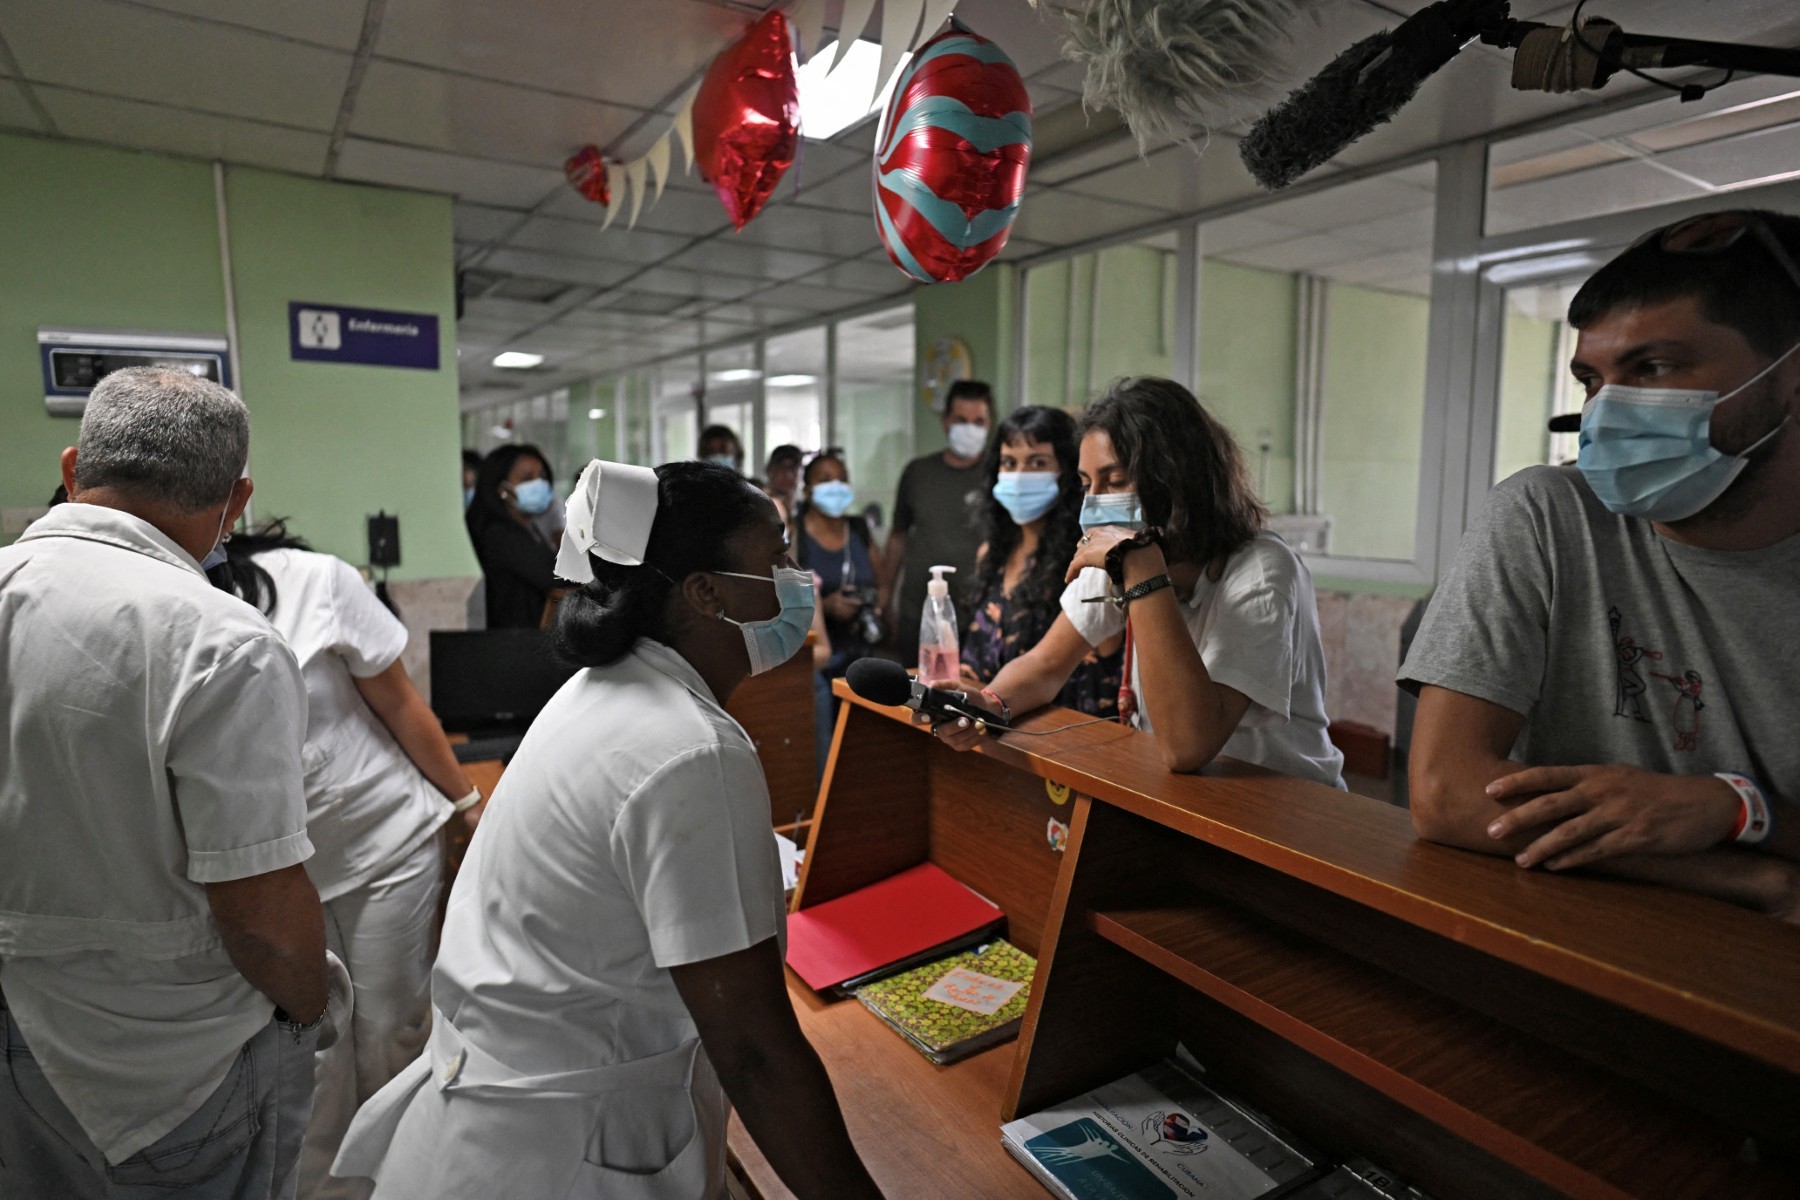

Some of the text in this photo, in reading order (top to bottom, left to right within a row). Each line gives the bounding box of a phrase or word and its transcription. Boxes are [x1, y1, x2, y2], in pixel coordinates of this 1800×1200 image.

[1092, 1111, 1118, 1133] HISTORIAS
[1141, 1151, 1149, 1160] DE
[1148, 1158, 1196, 1198] REHABILITACION
[1177, 1163, 1204, 1187] CUBANA
